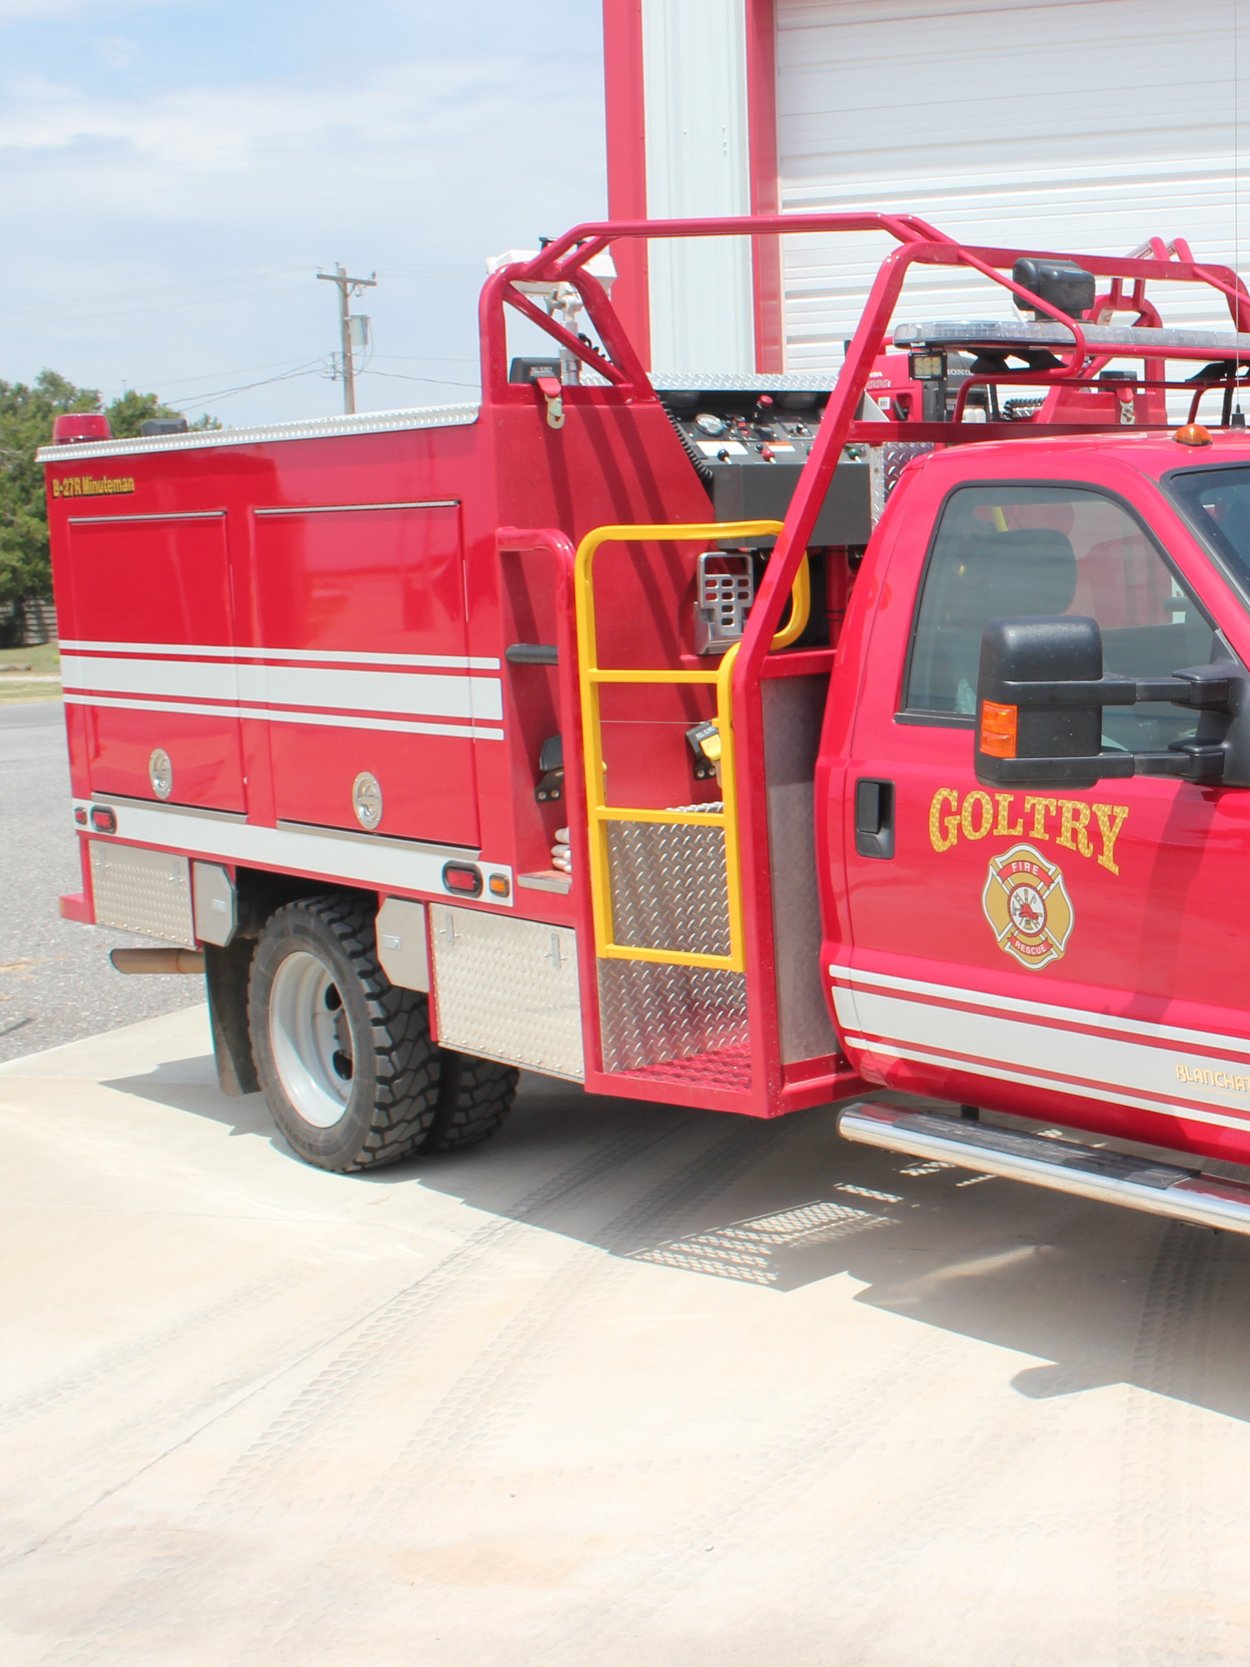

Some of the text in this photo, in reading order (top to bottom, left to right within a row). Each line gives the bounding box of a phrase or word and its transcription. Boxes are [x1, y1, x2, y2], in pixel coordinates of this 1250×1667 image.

[82, 475, 135, 495] Minuteman
[928, 787, 1129, 876] GOLTRY
[1011, 861, 1039, 875] FIRE
[1014, 940, 1047, 955] RESCUE
